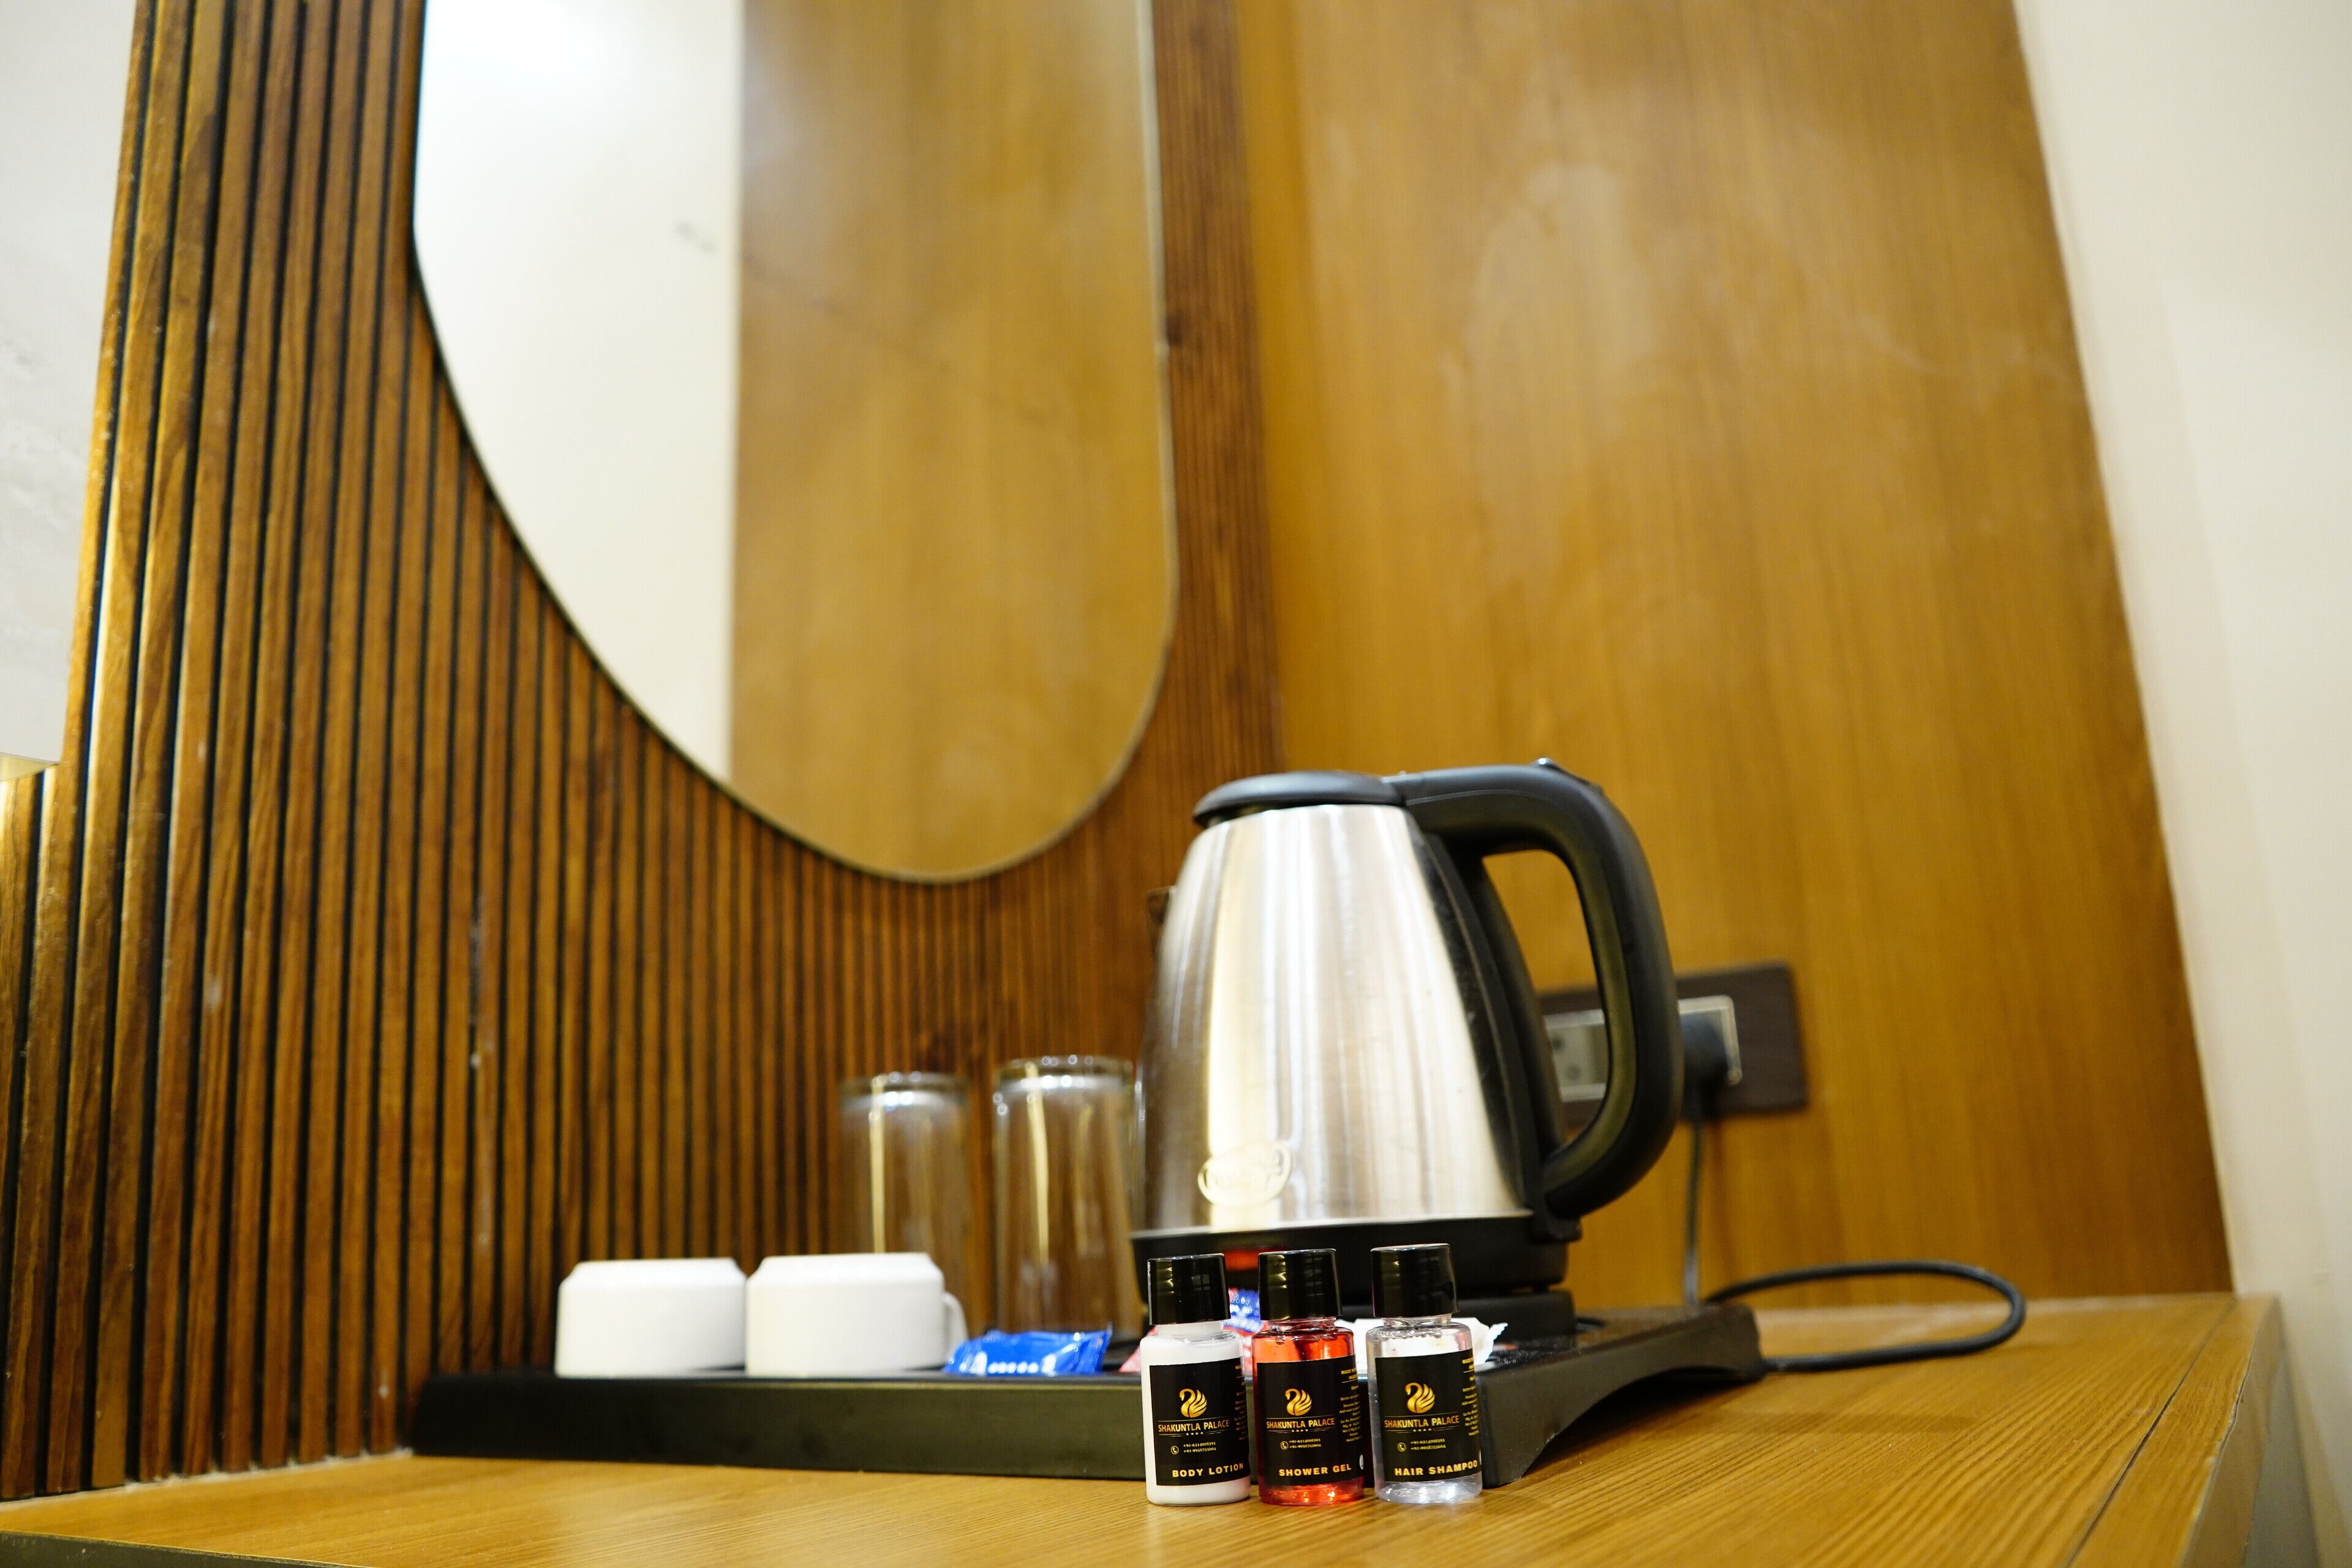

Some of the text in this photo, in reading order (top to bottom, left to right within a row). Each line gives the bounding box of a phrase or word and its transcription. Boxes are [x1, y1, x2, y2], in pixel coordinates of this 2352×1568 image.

[1158, 1423, 1200, 1432] SHAKUNTLA
[1204, 1419, 1230, 1430] PALACE
[1266, 1420, 1306, 1429] SHAKUNTLA
[1308, 1417, 1336, 1427] PALACE
[1384, 1418, 1429, 1428] SHAKUNTLA
[1431, 1415, 1460, 1426] PALACE
[1172, 1463, 1243, 1477] BODY LOTION
[1278, 1463, 1352, 1476] SHOWER GEL
[1428, 1460, 1478, 1475] SHAMPOO
